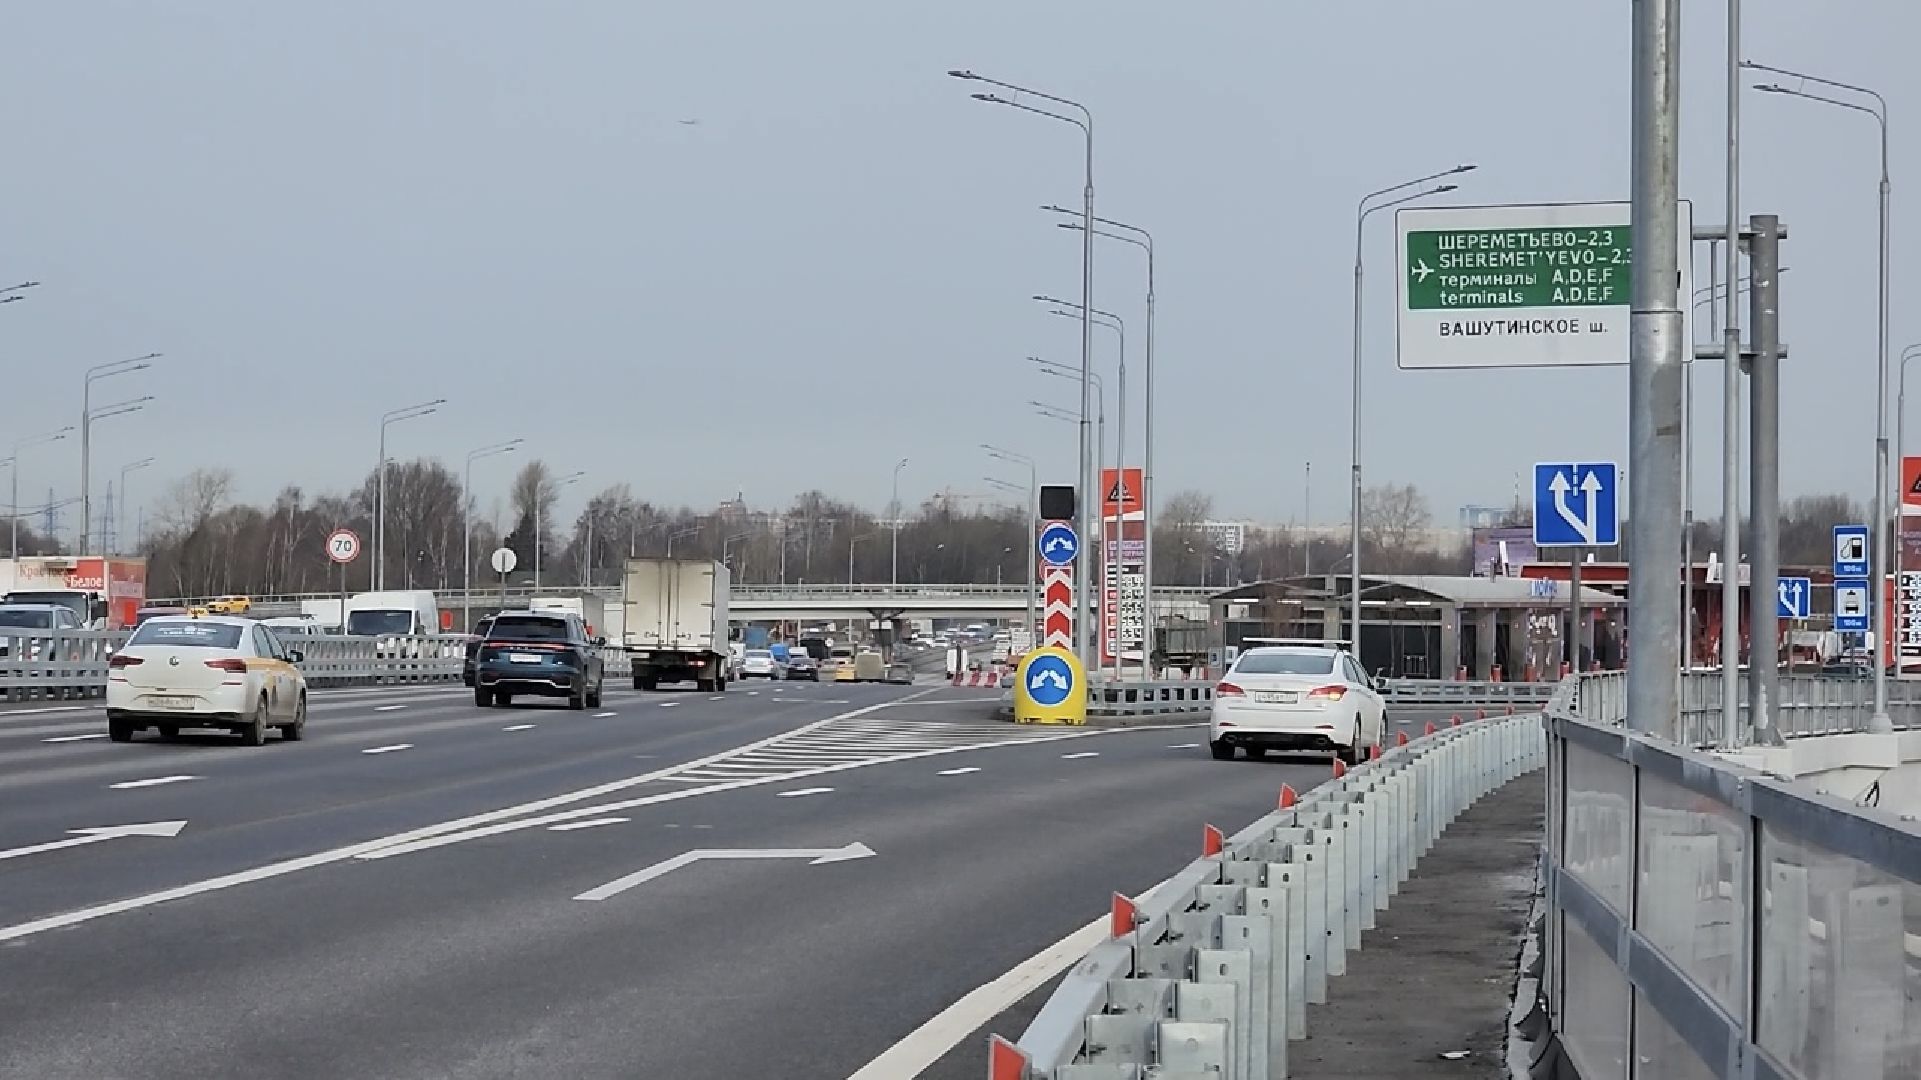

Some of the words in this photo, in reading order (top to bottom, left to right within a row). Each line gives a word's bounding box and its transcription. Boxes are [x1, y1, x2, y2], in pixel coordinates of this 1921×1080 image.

[1439, 272, 1537, 290] терминалы
[1440, 287, 1524, 305] terminals
[1439, 319, 1579, 337] ВАШУТИНСКОЕ
[1589, 321, 1609, 334] ш.
[335, 540, 352, 551] 70
